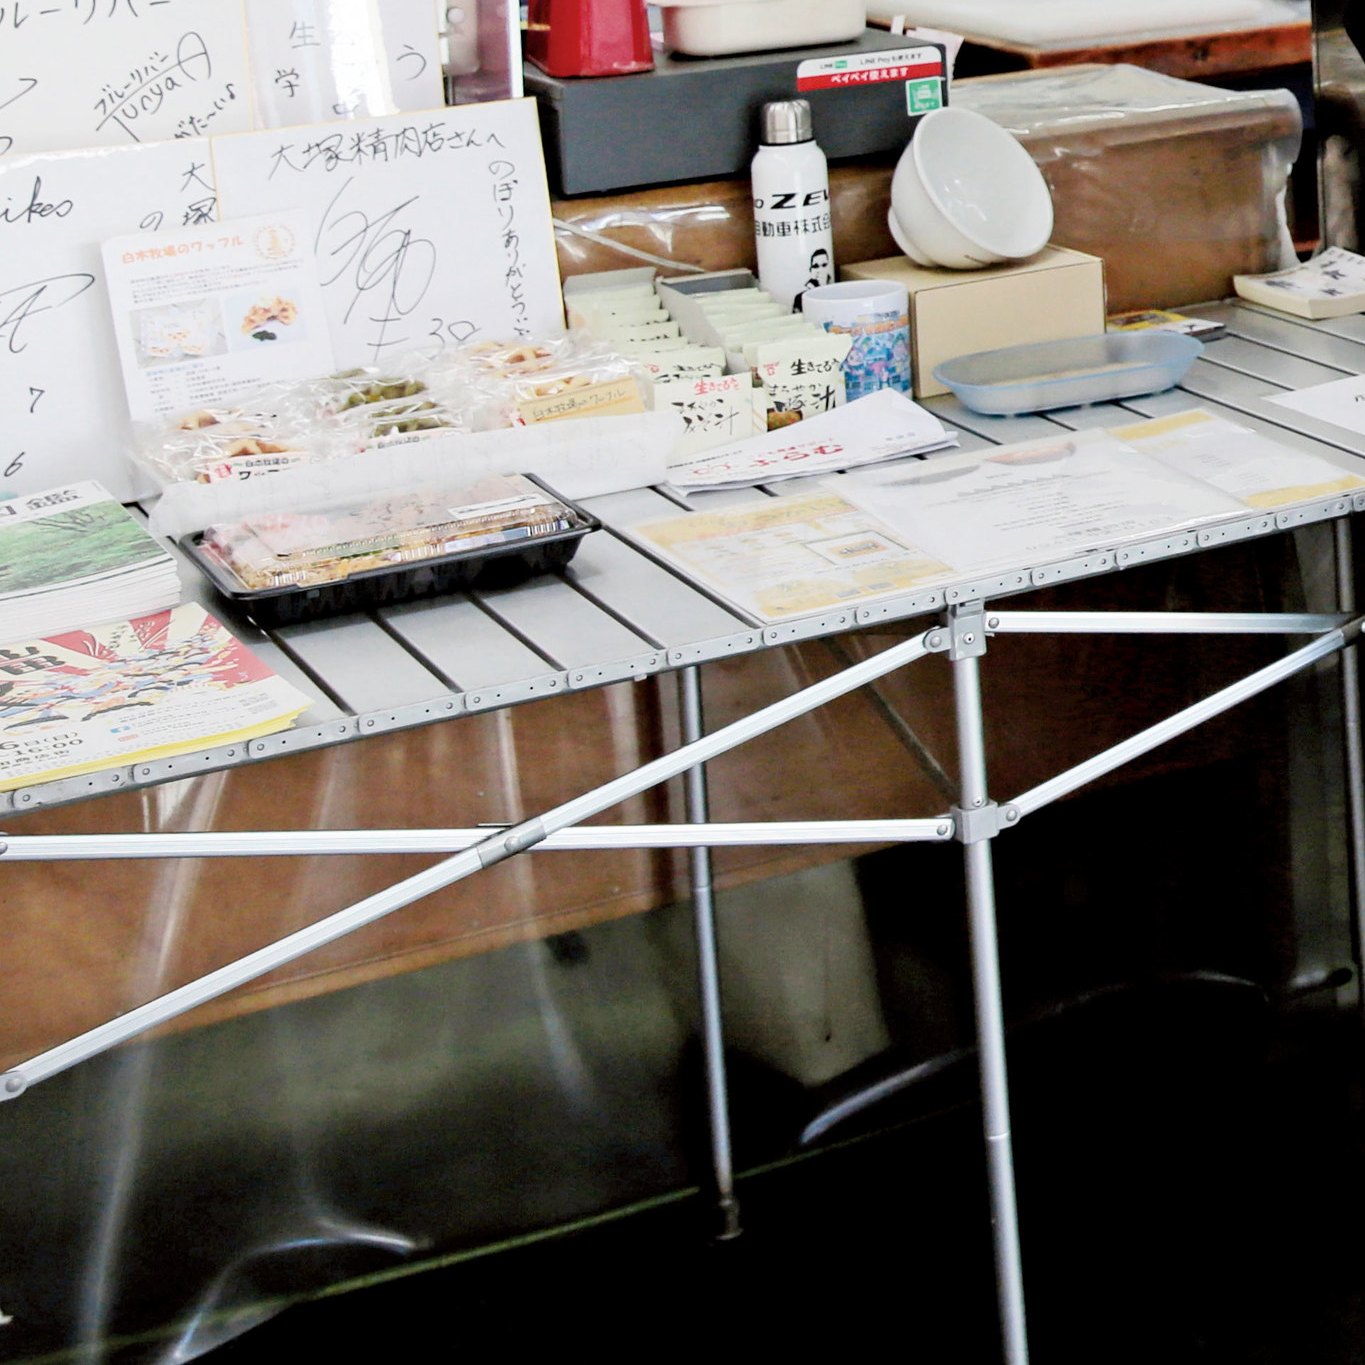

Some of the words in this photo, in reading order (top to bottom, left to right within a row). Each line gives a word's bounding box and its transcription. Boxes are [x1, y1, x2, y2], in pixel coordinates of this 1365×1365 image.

[289, 20, 321, 49] 生
[275, 67, 300, 98] 学
[831, 66, 909, 84] ペイペイ使えます
[268, 122, 507, 181] 大塚精肉店さんへ
